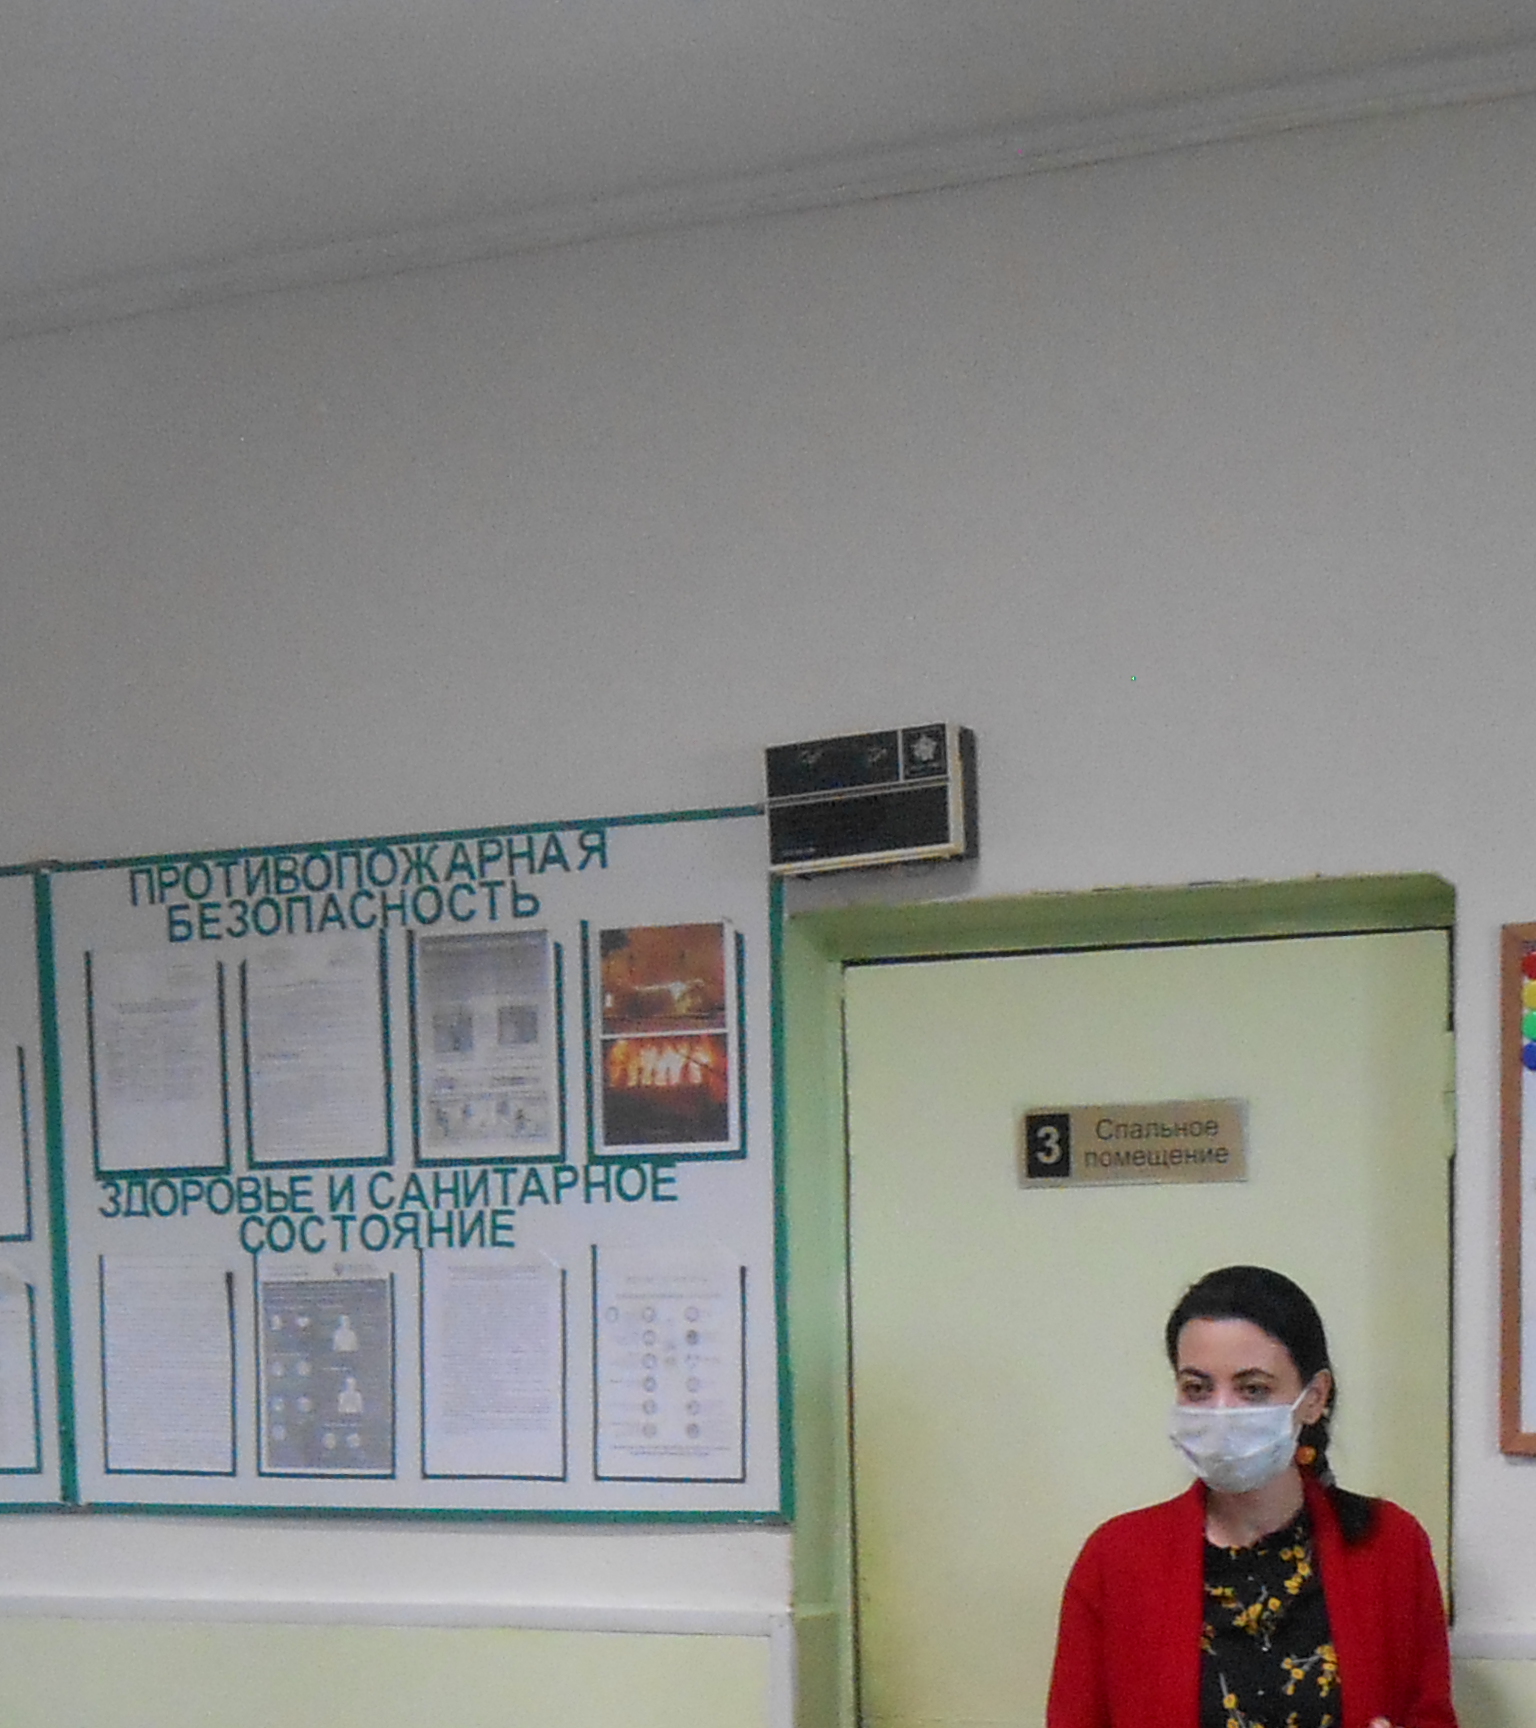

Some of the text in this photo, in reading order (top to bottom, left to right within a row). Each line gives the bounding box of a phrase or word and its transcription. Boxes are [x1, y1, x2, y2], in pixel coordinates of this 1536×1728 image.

[128, 829, 609, 907] ПРОТИВОПОЖАРНАЯ
[166, 880, 541, 943] БЕЗОПАСНОСТЬ
[1036, 1126, 1062, 1165] 3
[1095, 1118, 1220, 1141] Спальное
[1085, 1145, 1230, 1169] помещение
[99, 1164, 679, 1219] ЗДОРОВЬЕ И САНИТАРНОЕ
[239, 1209, 516, 1255] СОСТОЯНИЕ
